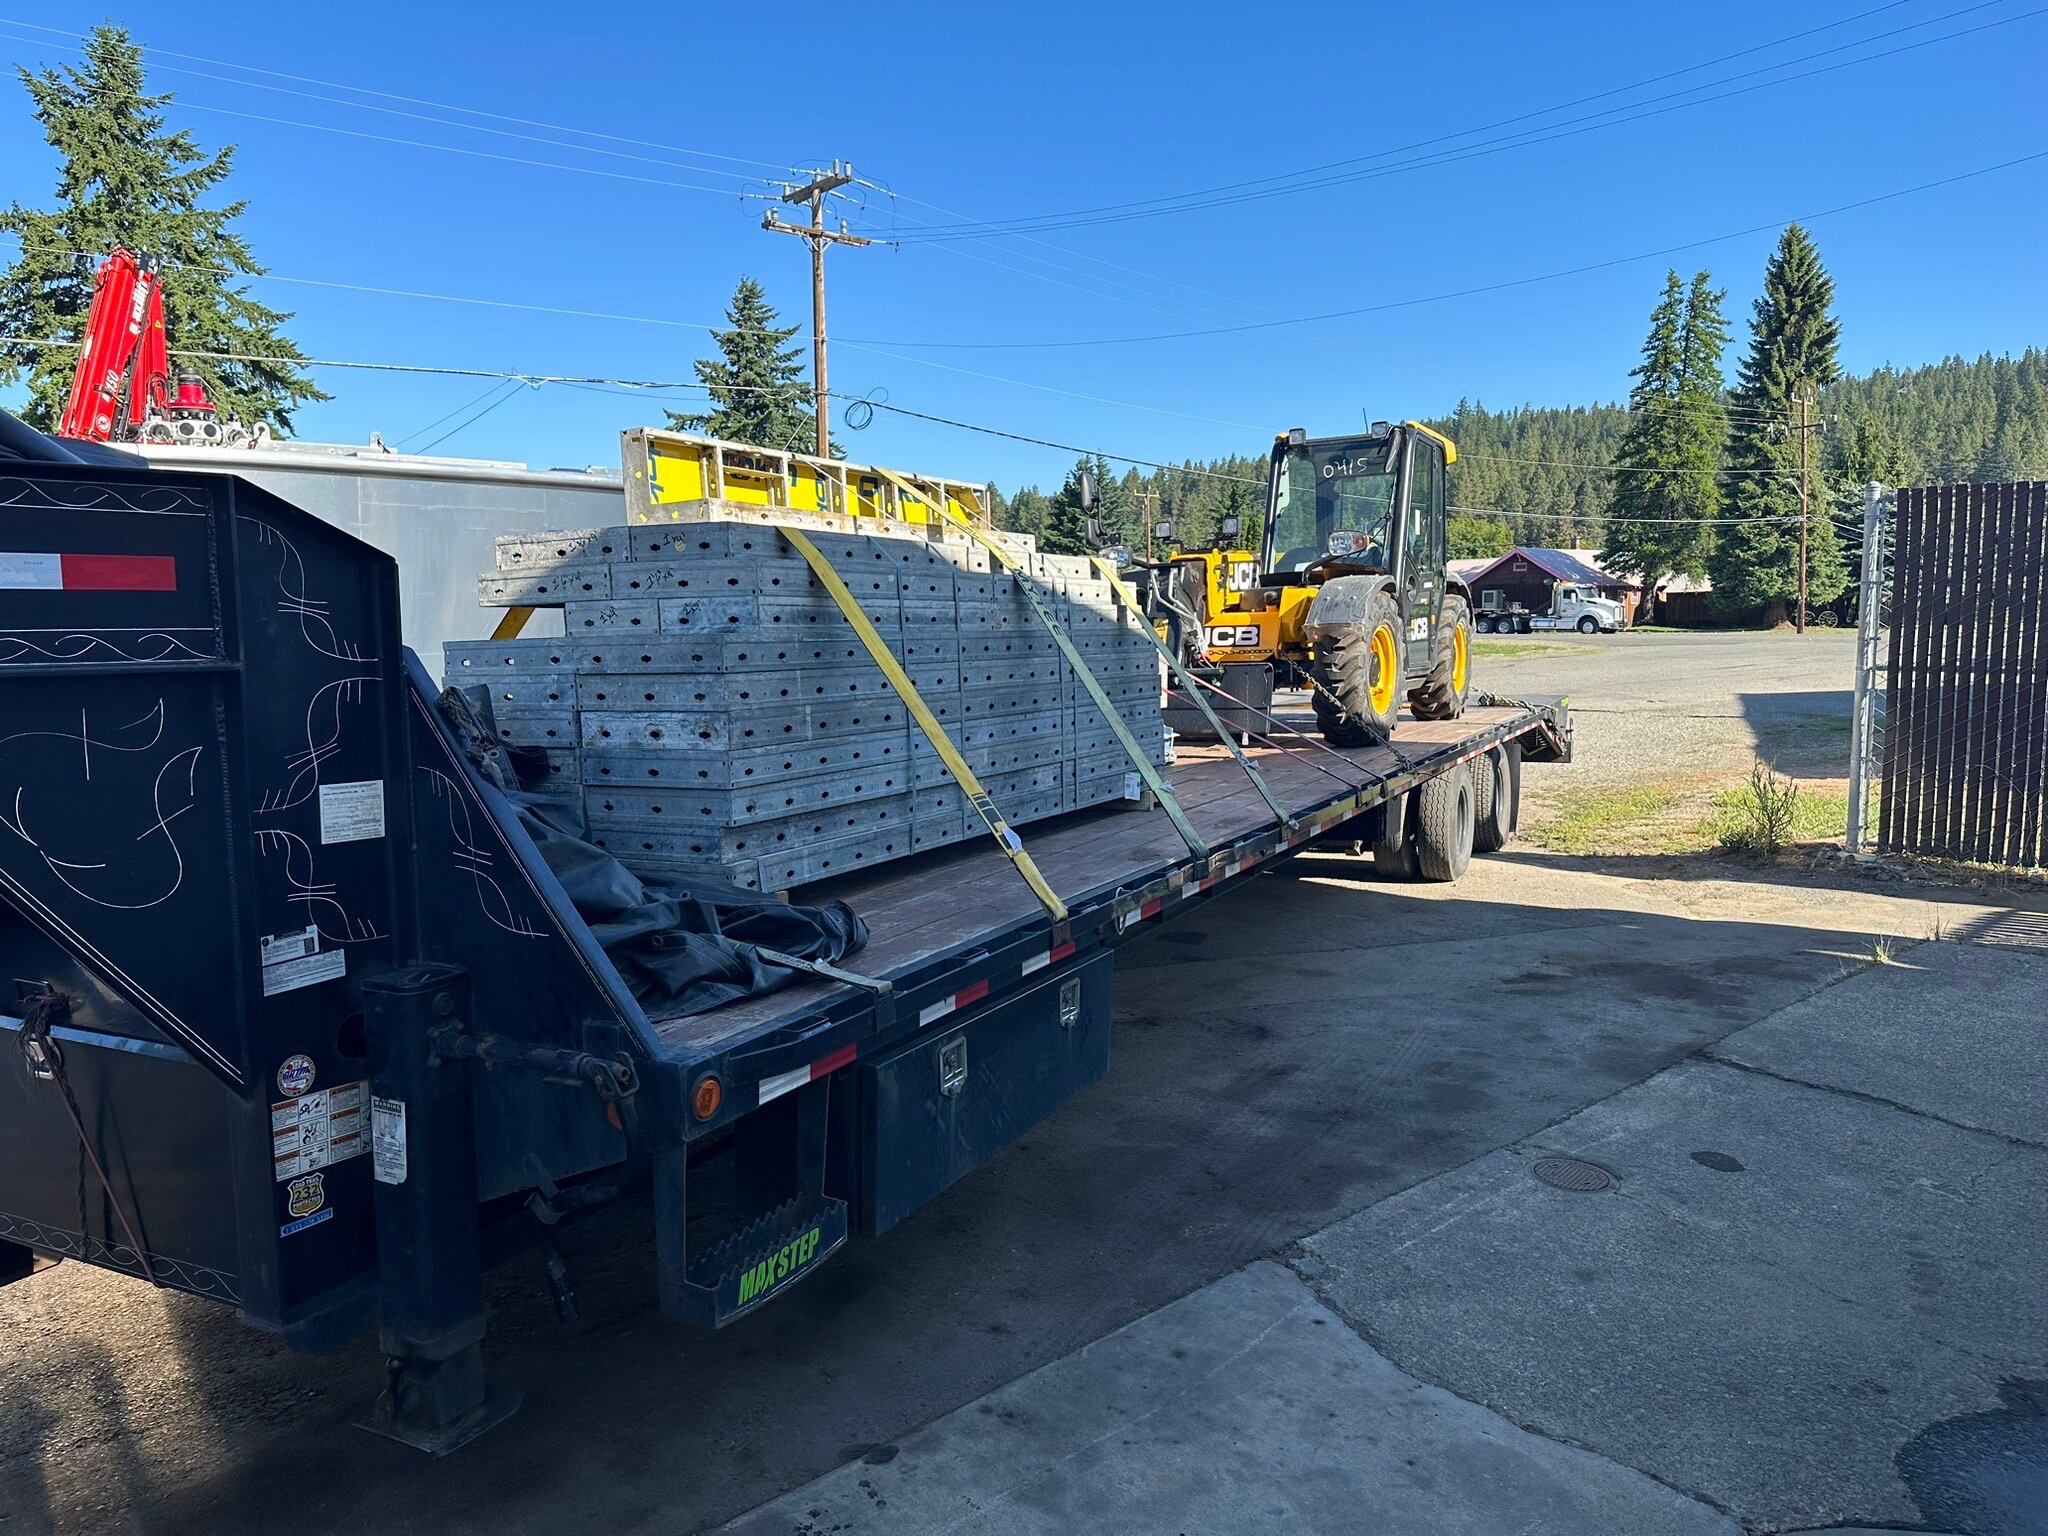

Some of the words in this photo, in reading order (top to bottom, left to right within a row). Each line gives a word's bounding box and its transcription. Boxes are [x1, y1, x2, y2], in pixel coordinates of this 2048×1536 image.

[1323, 457, 1368, 478] 0415
[294, 1184, 318, 1201] 232
[737, 1226, 820, 1306] MAXSTEP
